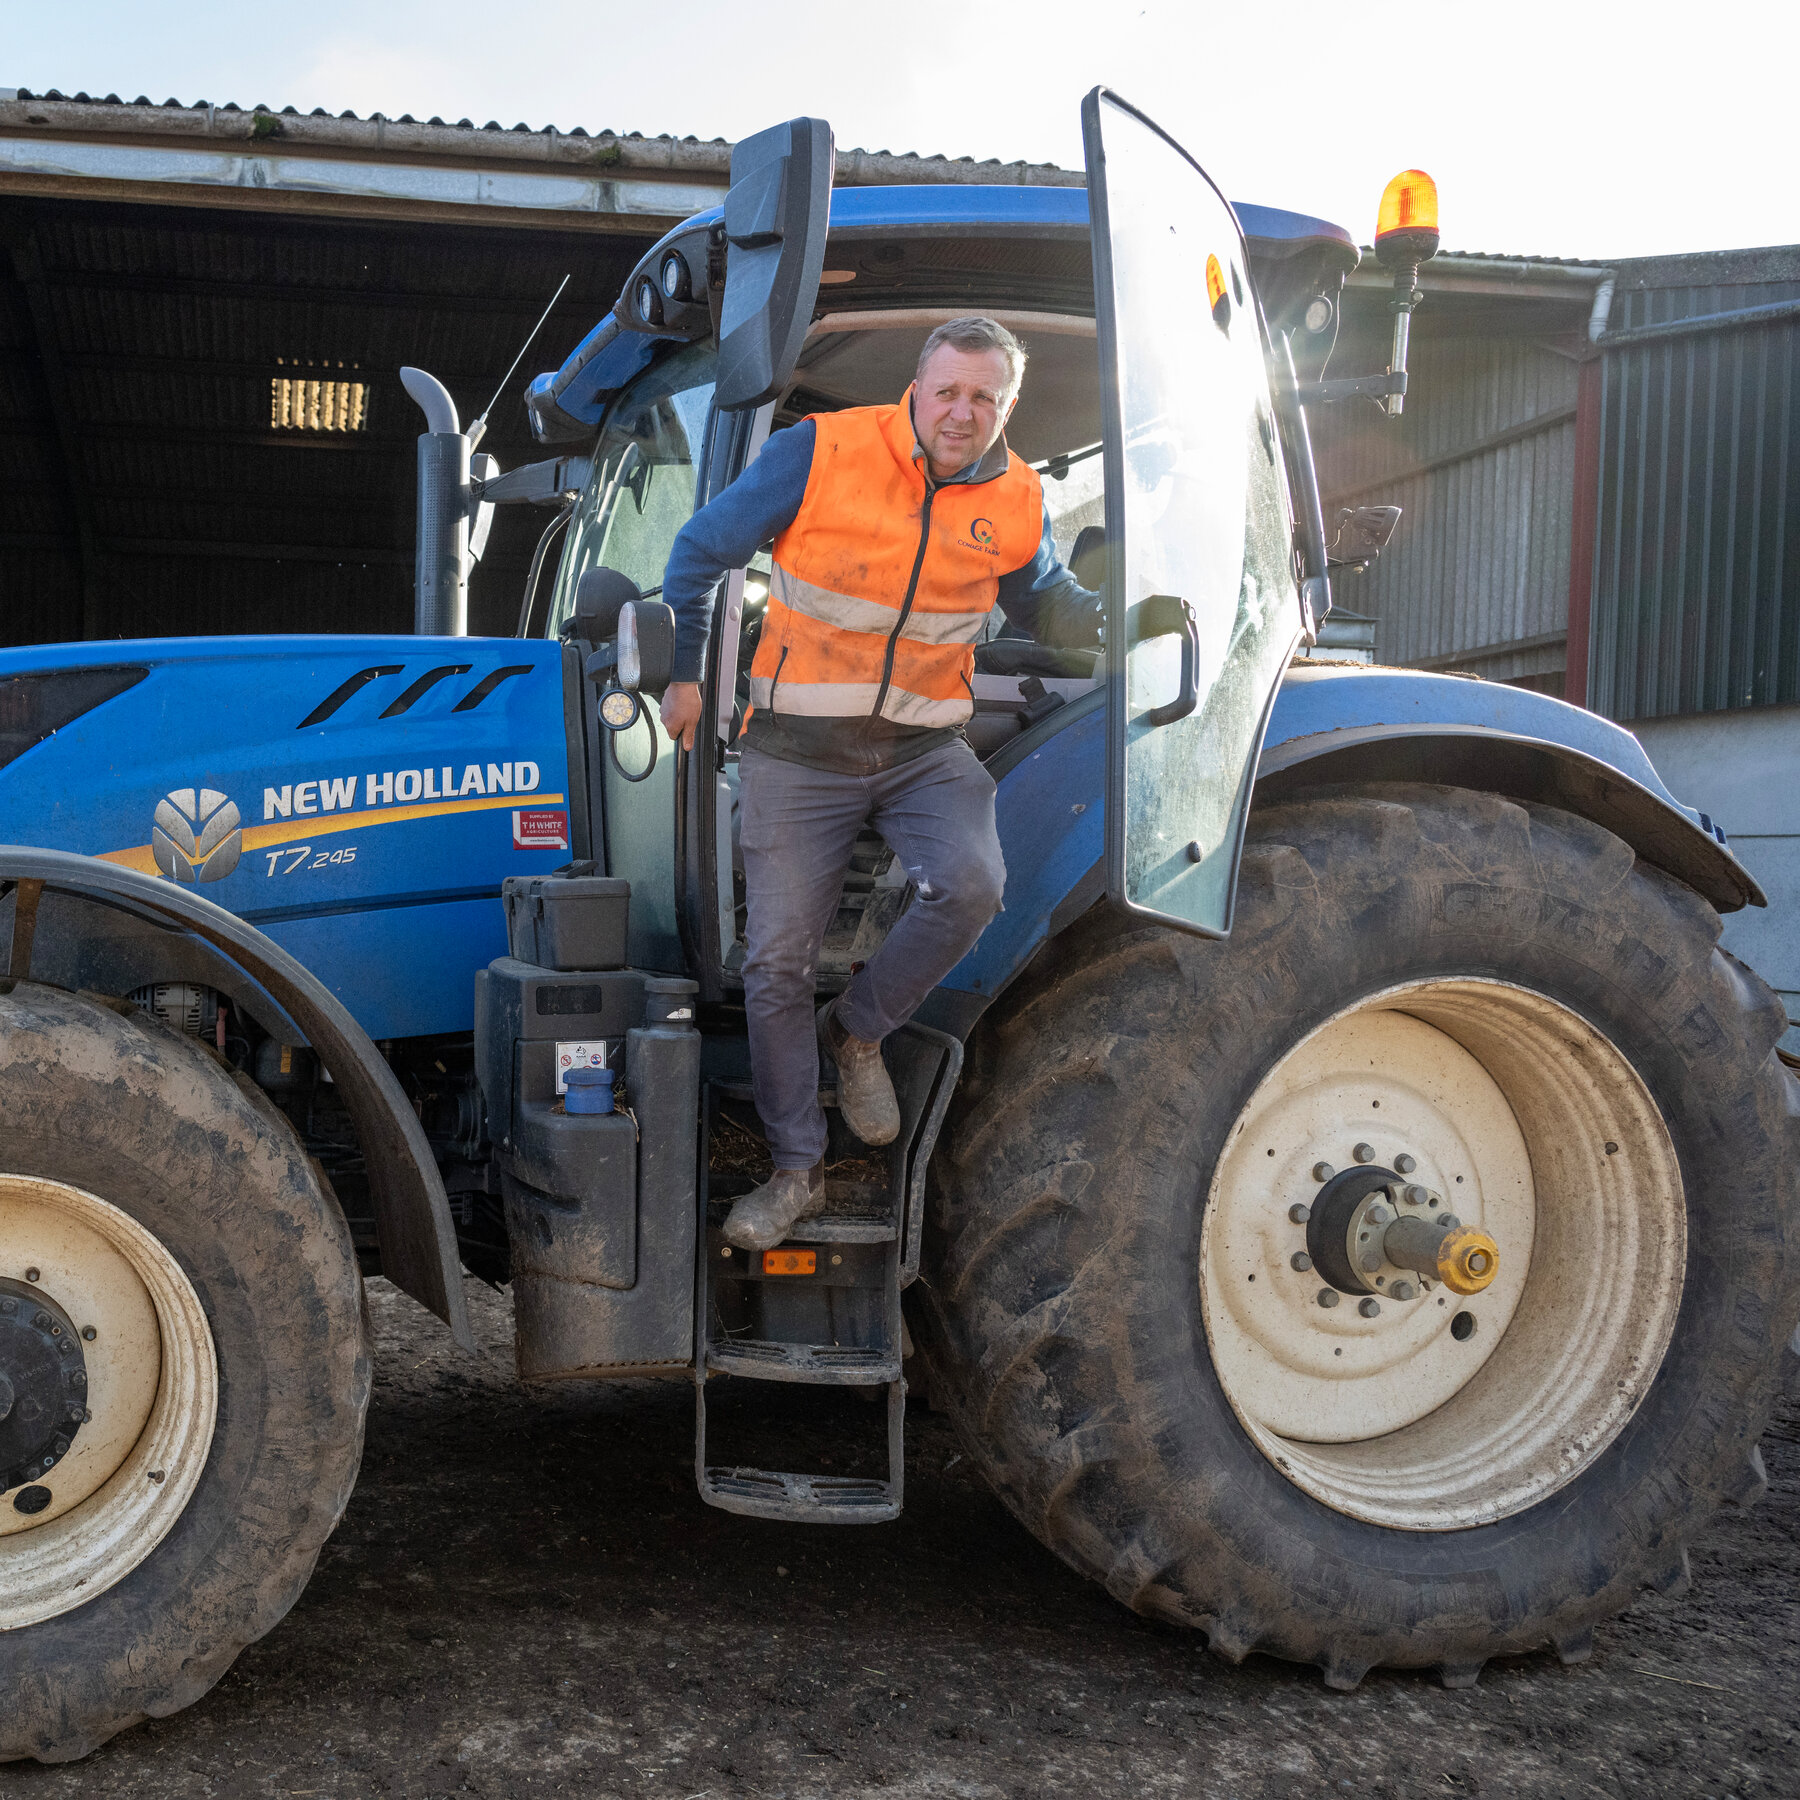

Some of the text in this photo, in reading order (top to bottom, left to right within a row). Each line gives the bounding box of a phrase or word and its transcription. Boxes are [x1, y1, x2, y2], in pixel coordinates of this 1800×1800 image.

[263, 761, 540, 820] NEW HOLLAND
[536, 821, 563, 829] WHITE
